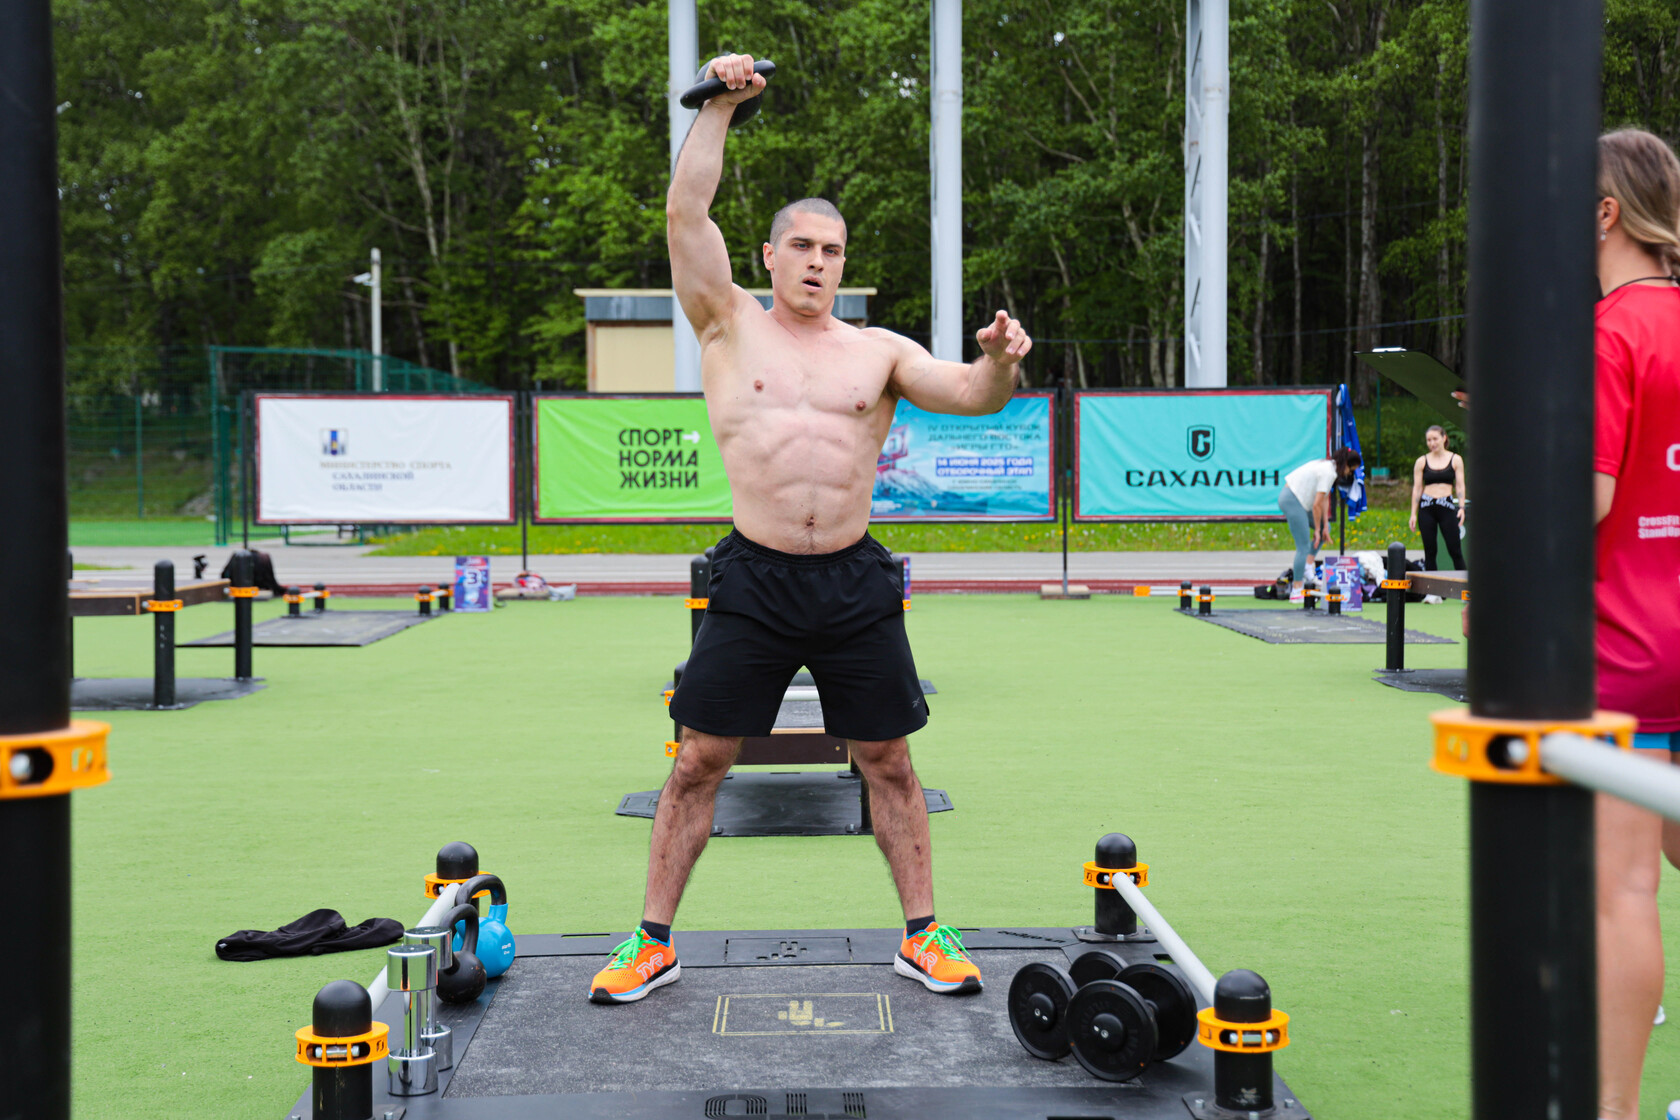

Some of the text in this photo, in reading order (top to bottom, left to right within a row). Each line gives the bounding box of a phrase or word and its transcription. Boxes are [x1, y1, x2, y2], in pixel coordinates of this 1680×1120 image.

[619, 428, 684, 446] СПОРТ
[619, 450, 698, 467] НОРМА
[620, 471, 698, 488] ЖИЗНИ
[1125, 470, 1280, 487] САХАЛИН
[465, 570, 481, 586] 3
[1336, 570, 1350, 586] 1
[636, 952, 664, 981] TYR
[913, 943, 938, 974] TYR
